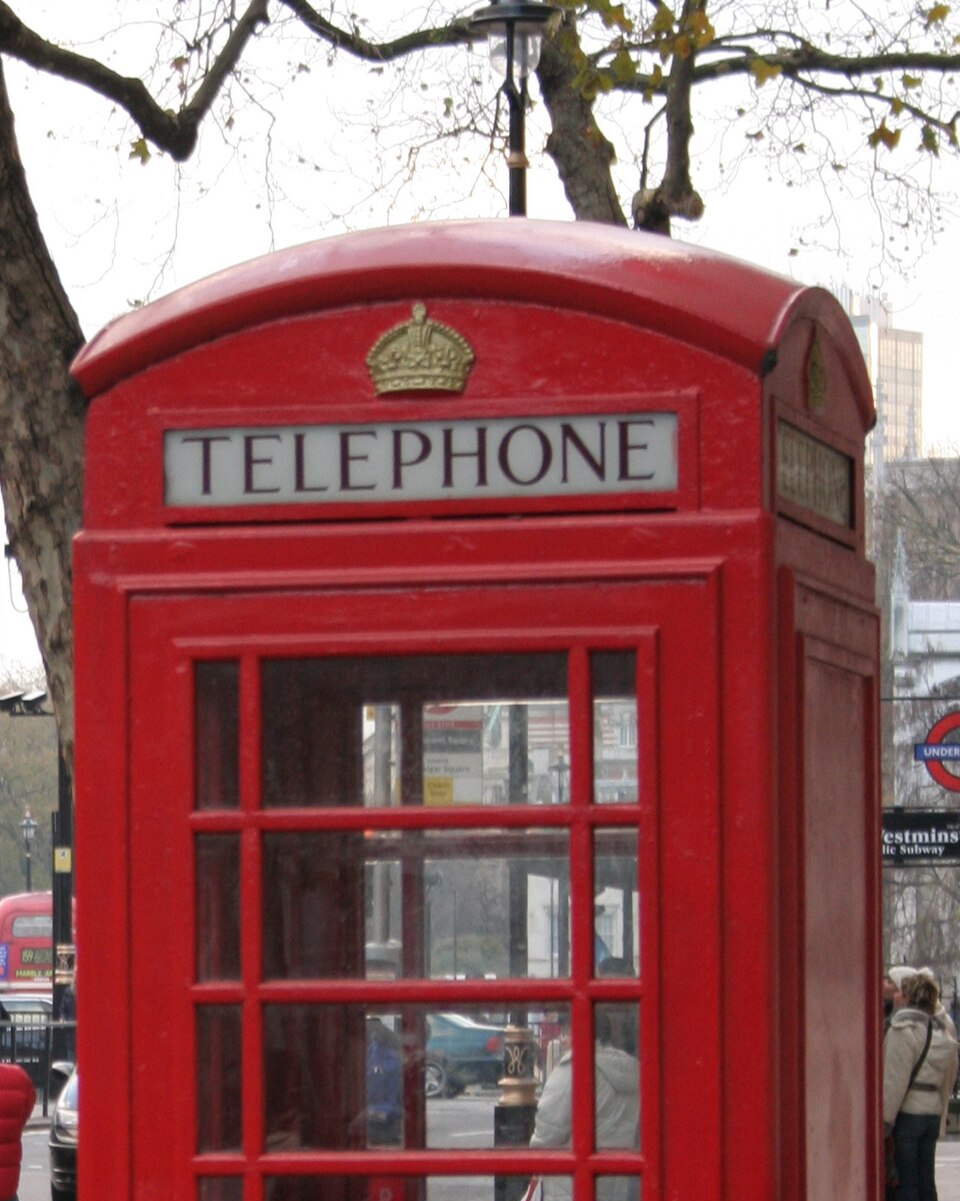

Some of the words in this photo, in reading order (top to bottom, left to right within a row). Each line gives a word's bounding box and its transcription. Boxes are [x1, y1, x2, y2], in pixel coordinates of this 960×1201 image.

[181, 419, 656, 495] TELEPHONE
[881, 828, 960, 845] estmins
[899, 844, 945, 858] Subway
